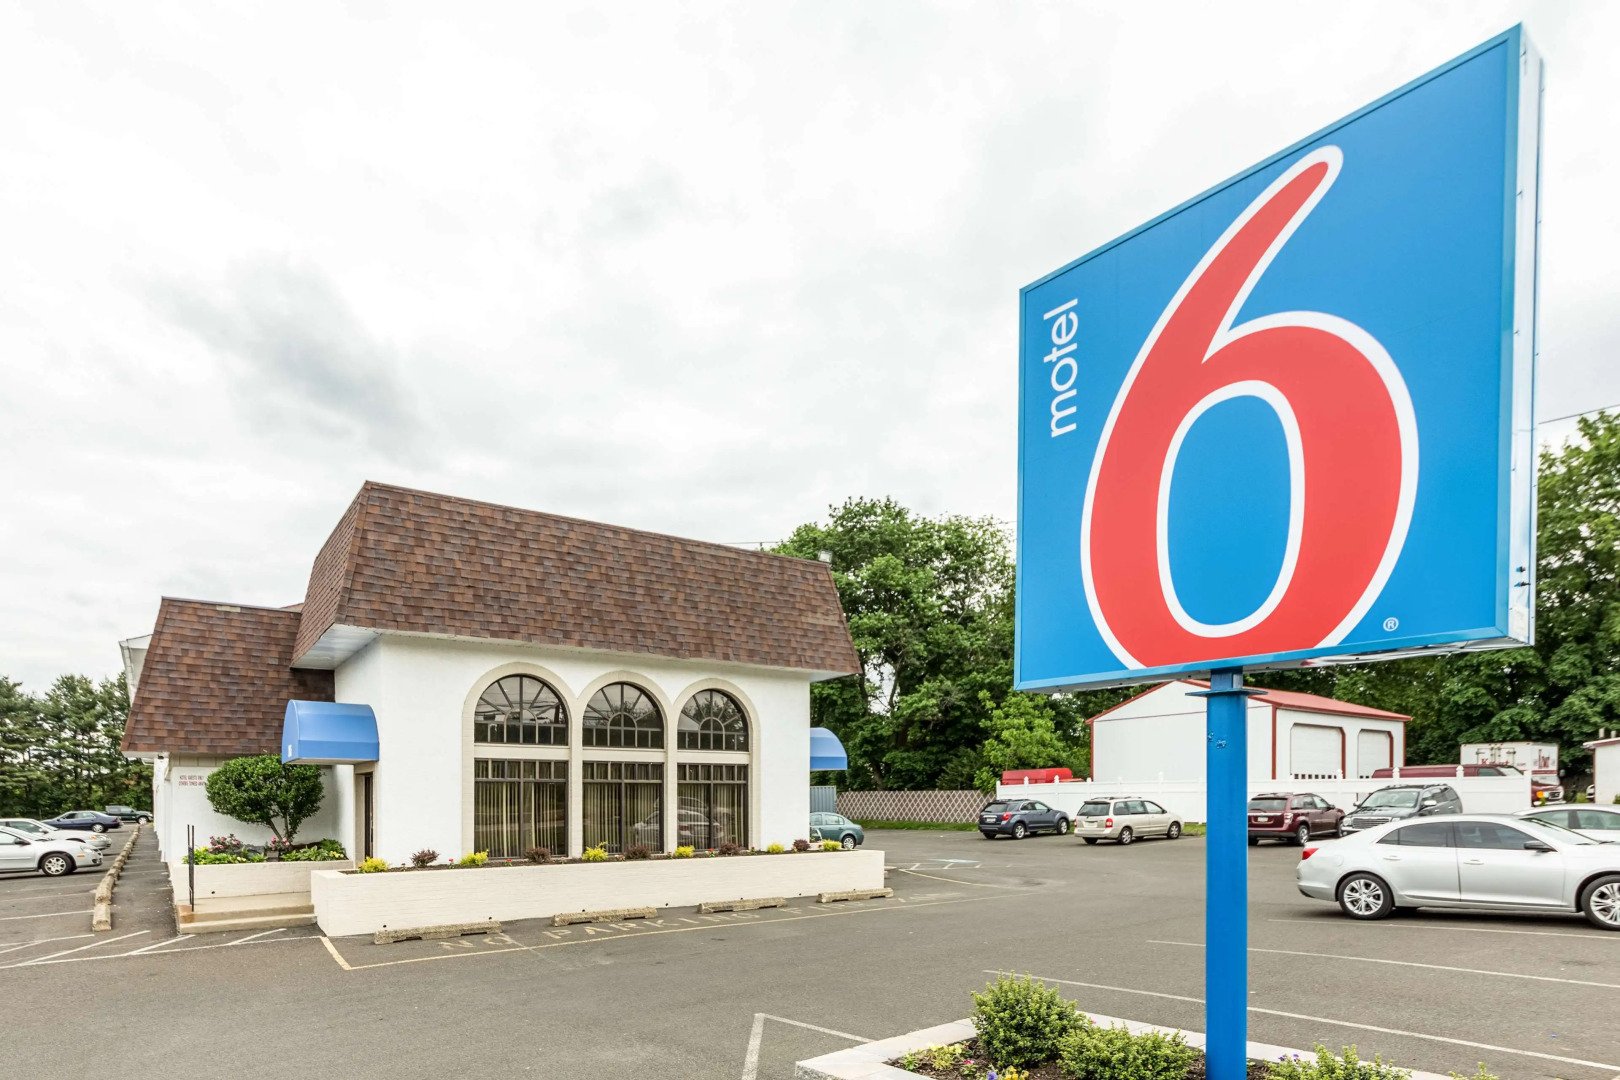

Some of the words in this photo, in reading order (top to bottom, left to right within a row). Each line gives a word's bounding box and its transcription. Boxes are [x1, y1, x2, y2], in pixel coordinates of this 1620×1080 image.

[1043, 298, 1079, 438] motel
[1080, 145, 1419, 670] 6
[438, 936, 514, 950] NO
[543, 913, 761, 939] PARKING
